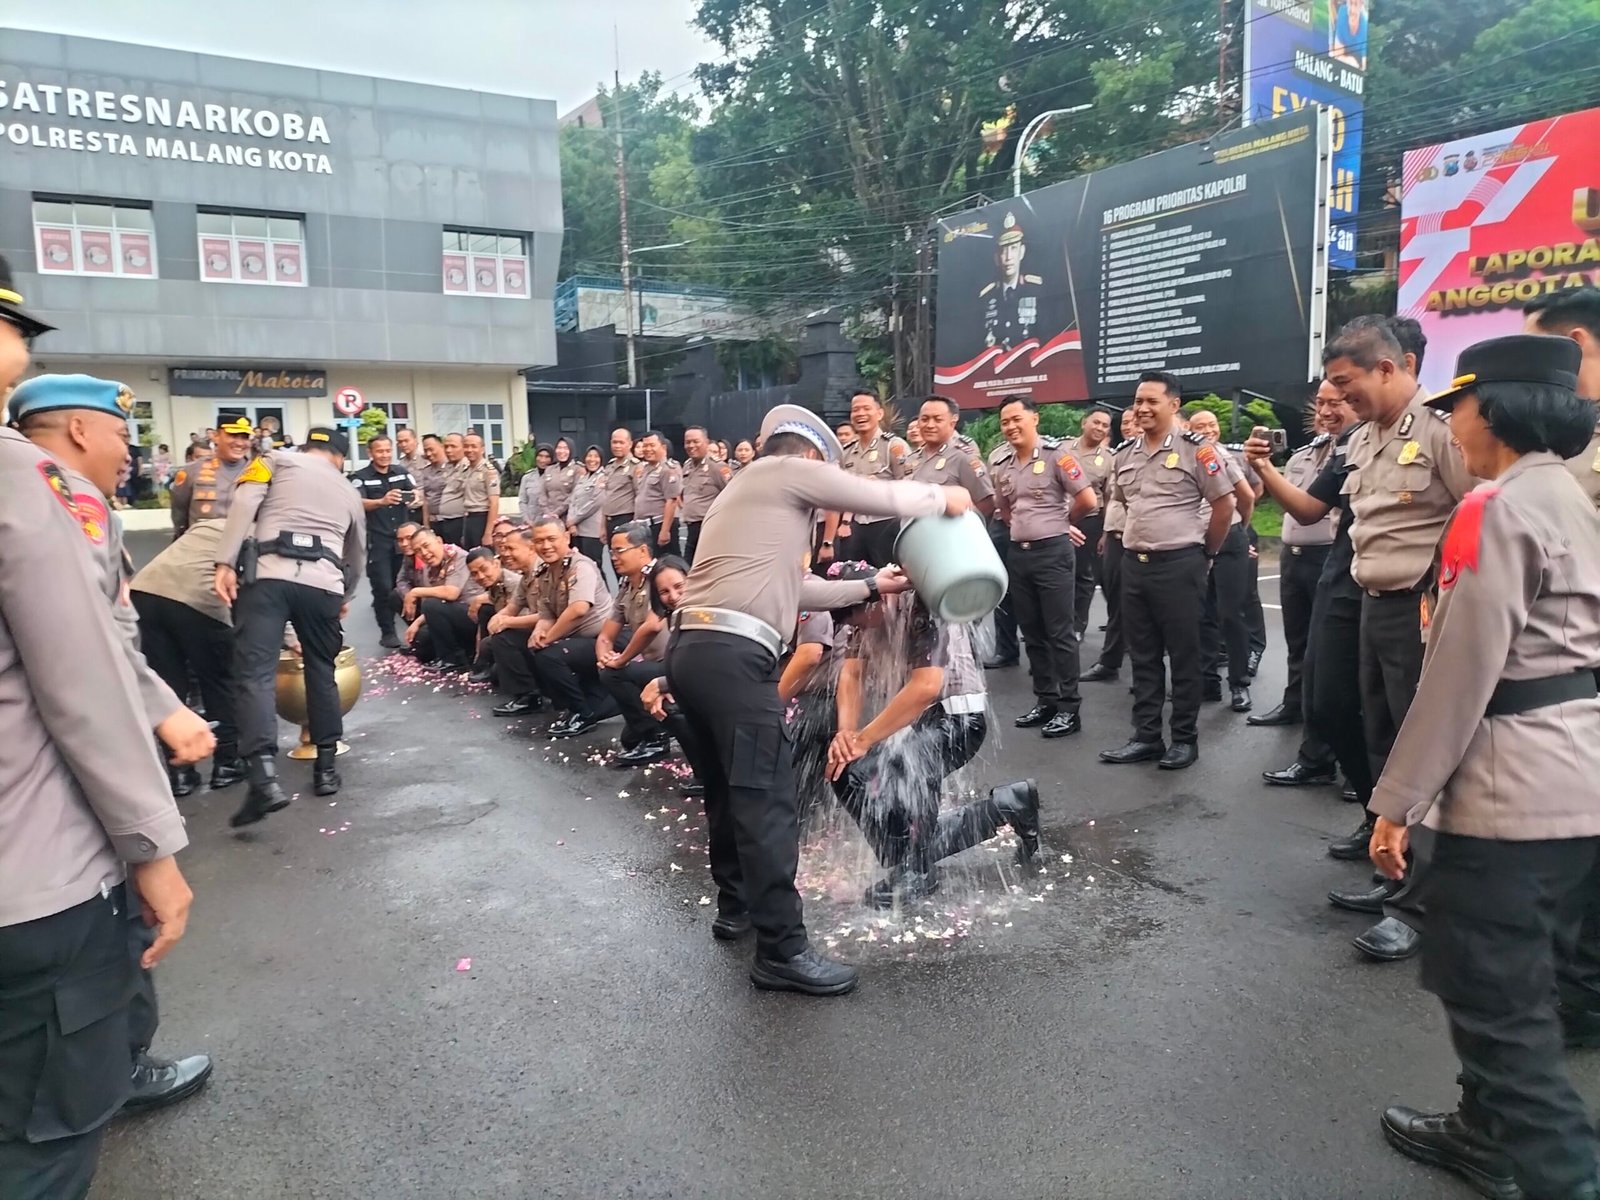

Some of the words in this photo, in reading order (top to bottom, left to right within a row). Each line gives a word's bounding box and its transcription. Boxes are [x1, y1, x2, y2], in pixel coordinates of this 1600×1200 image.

[1295, 50, 1333, 82] MALANG
[1340, 69, 1364, 94] BATU
[145, 137, 262, 167] MALANG
[267, 149, 333, 174] KOTA
[1103, 209, 1113, 225] 16
[1113, 197, 1155, 223] PROGRAM
[1156, 185, 1203, 212] PRIORITAS
[1204, 173, 1247, 200] KAPOLRI
[235, 371, 325, 394] Makota
